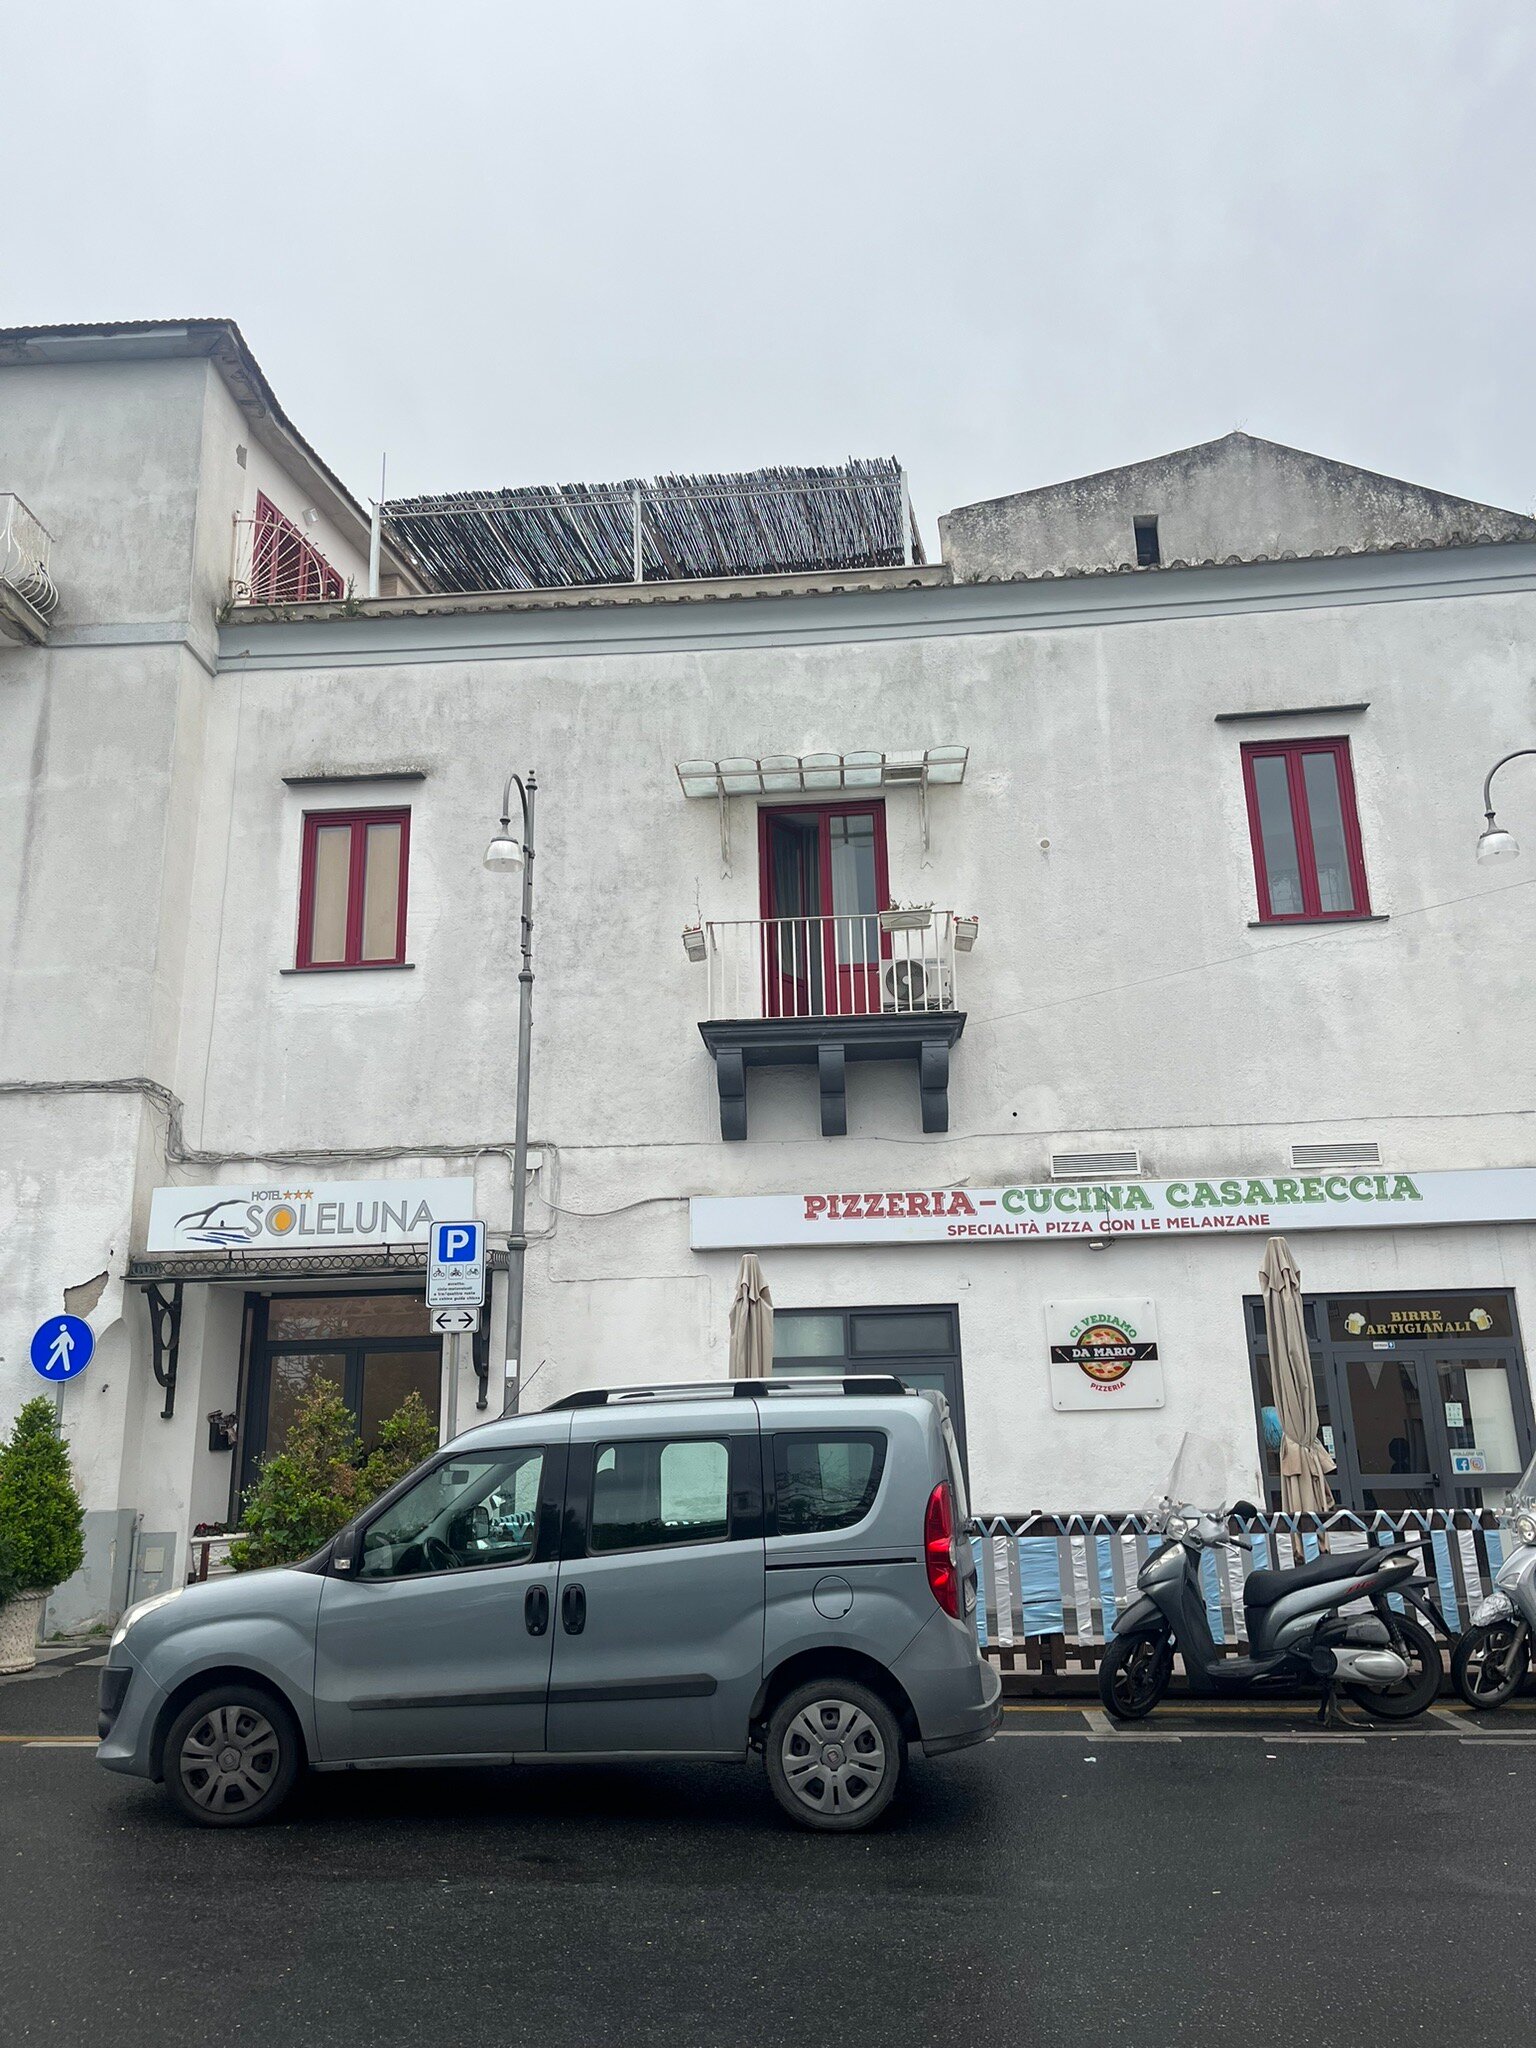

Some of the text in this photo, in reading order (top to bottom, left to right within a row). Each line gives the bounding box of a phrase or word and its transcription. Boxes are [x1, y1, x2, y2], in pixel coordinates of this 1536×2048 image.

[251, 1190, 282, 1201] HOTEL
[803, 1191, 978, 1220] PIZZERIA
[1001, 1184, 1154, 1214] CUCINA
[1165, 1174, 1423, 1209] CASARECCIA
[243, 1200, 434, 1238] SOLELUNA
[947, 1214, 1271, 1236] SPECIALITÀ PIZZA CON LE MELANZANE
[446, 1229, 470, 1259] P
[1390, 1310, 1442, 1322] BIRRE
[1080, 1313, 1138, 1339] VEDIAMO
[1366, 1321, 1472, 1335] ARTIGIANALI
[1072, 1346, 1137, 1358] DA MARIO
[1089, 1381, 1127, 1393] PIZZERIA
